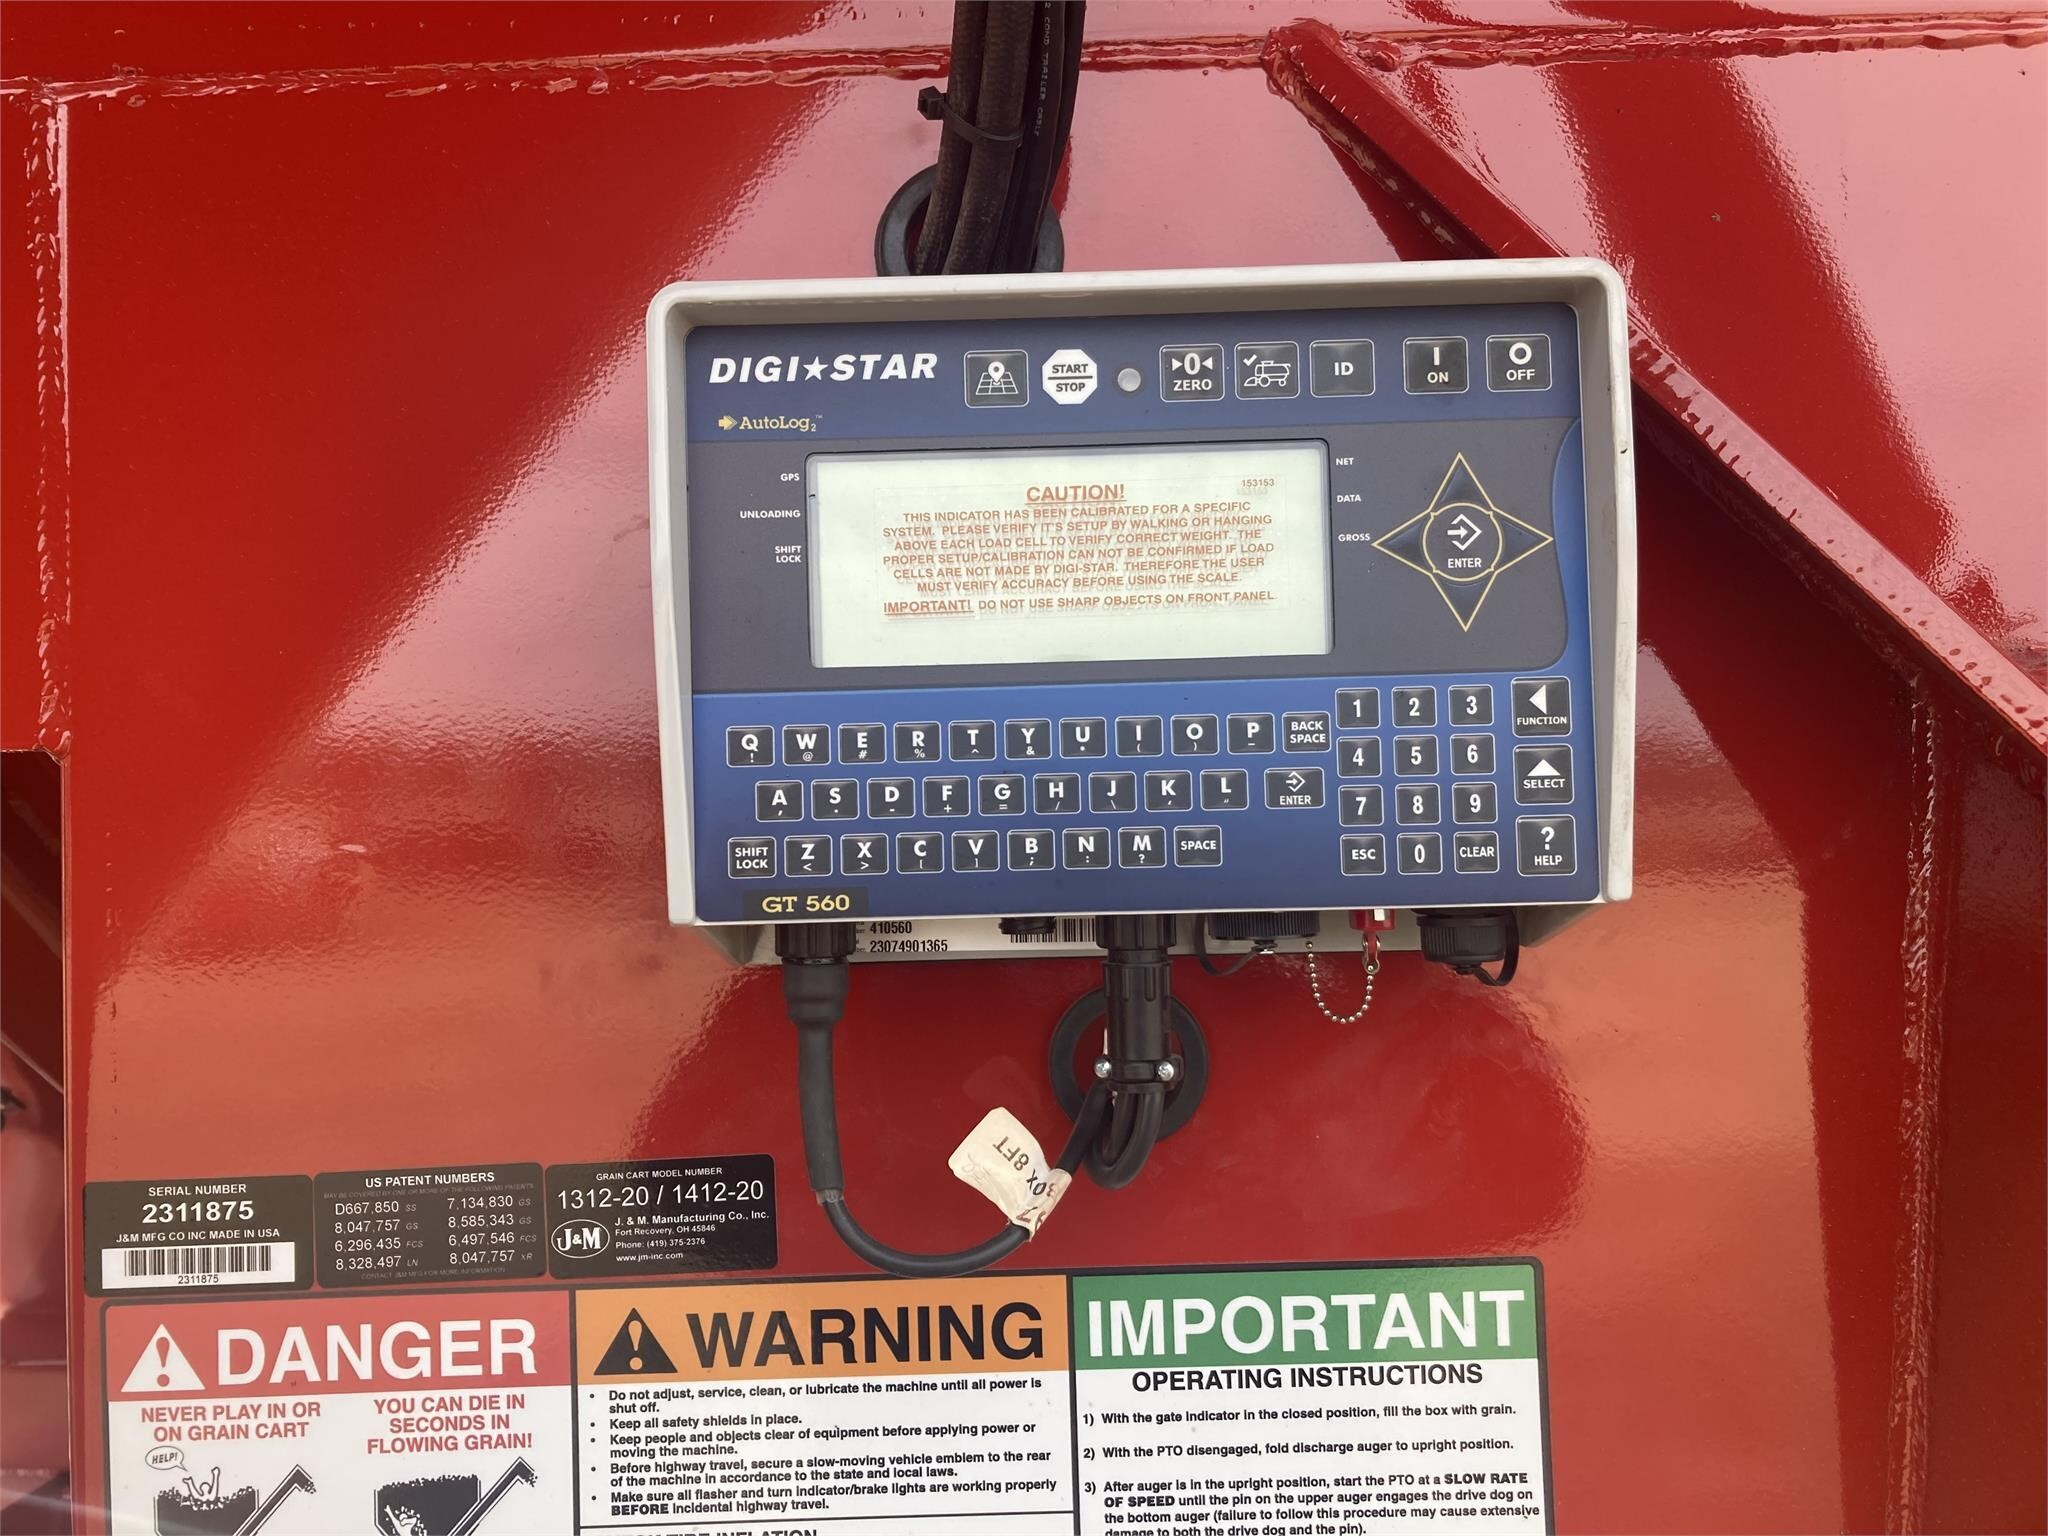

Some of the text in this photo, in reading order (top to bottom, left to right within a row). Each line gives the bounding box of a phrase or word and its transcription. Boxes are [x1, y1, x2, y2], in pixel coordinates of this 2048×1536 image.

[1051, 363, 1089, 375] START
[1334, 362, 1354, 376] ID
[1506, 369, 1536, 381] OFF
[1427, 371, 1449, 384] ON
[1056, 382, 1086, 394] STOP
[1173, 378, 1213, 392] ZERO
[1336, 457, 1354, 466] NET
[780, 473, 800, 482] GPS
[1242, 479, 1275, 488] 153153
[1026, 484, 1126, 505] CAUTION!
[1337, 494, 1362, 503] DATA
[740, 509, 801, 519] UNLOADING
[904, 502, 1251, 522] THIS INDICATOR HAS BEEN CALIBRATED FOR A SPECIFIC
[1338, 533, 1370, 543] GROSS
[774, 545, 802, 555] SHIFT
[776, 554, 801, 564] LOCK
[1447, 557, 1482, 569] ENTER
[883, 600, 974, 615] IMPORTANT!
[979, 600, 996, 610] DO
[1001, 599, 1026, 609] NOT
[1029, 599, 1053, 608] USE
[1058, 596, 1100, 608] SHARP
[1105, 595, 1162, 606] OBJECTS
[1166, 594, 1184, 604] ON
[1188, 592, 1230, 603] FRONT
[1353, 699, 1362, 718] 1
[1409, 698, 1420, 716] 2
[1466, 696, 1478, 715] 3
[1291, 721, 1323, 732] BACK
[1517, 716, 1568, 726] FUNCTION
[1290, 733, 1326, 744] SPACE
[1353, 748, 1365, 766] 4
[1410, 746, 1422, 765] 5
[1466, 745, 1479, 763] 6
[1523, 778, 1565, 790] SELECT
[1279, 795, 1311, 806] ENTER
[1355, 797, 1366, 815] 7
[1412, 796, 1424, 814] 8
[1469, 794, 1481, 813] 9
[1180, 839, 1217, 851] SPACE
[1459, 846, 1495, 858] CLEAR
[735, 847, 769, 859] SHIFT
[1352, 848, 1376, 860] ESC
[1414, 844, 1426, 863] 0
[736, 858, 768, 870] LOCK
[1534, 854, 1563, 867] HELP
[762, 894, 850, 913] GT 560
[870, 921, 912, 934] 410560
[870, 939, 948, 953] 23074901365
[993, 1136, 1030, 1172] 8FT
[366, 1172, 495, 1188] US PATENT NUMBERS
[596, 1167, 723, 1181] GRAIN CART MODEL NUMBER
[148, 1184, 247, 1197] SERIAL NUMBER
[558, 1180, 764, 1210] 1312-20 1412-20
[335, 1201, 399, 1216] D667,850
[448, 1196, 513, 1210] 7,134,830
[142, 1200, 254, 1224] 2311875
[615, 1210, 769, 1226] J. & M. Manufacturing Co., Inc.
[335, 1220, 400, 1234] 8,047,757
[448, 1214, 514, 1229] 8,585,343
[677, 1225, 690, 1233] OH
[692, 1224, 716, 1233] 45846
[116, 1228, 280, 1243] J&M MFG CO INC MADE IN USA
[449, 1232, 515, 1247] 6,497,546
[556, 1227, 602, 1251] J&M
[335, 1238, 401, 1252] 6,296,435
[616, 1237, 706, 1249] Phone: (419) 375-2376
[336, 1256, 402, 1271] 8,328,497
[450, 1250, 515, 1265] 8,047,757
[616, 1252, 683, 1263] www.jm-inc.com
[178, 1274, 220, 1285] 2311875
[1088, 1290, 1525, 1357] IMPORTANT
[686, 1302, 1044, 1369] WARNING
[217, 1318, 537, 1386] DANGER
[1132, 1364, 1483, 1392] OPERATING INSTRUCTIONS
[374, 1394, 525, 1415] YOU CAN DIE IN
[142, 1402, 322, 1423] NEVER PLAY IN OR
[390, 1414, 510, 1433] SECONDS IN
[610, 1413, 802, 1433] Keep all safety shields in place.
[153, 1422, 309, 1442] ON GRAIN CART
[367, 1433, 532, 1454] FLOWING GRAIN!
[1083, 1437, 1514, 1462] 2) With the PTO disengaged, fold discharge auger to upright position.
[151, 1452, 179, 1466] HELP!
[611, 1497, 830, 1517] BEFORE incidental highway travel.
